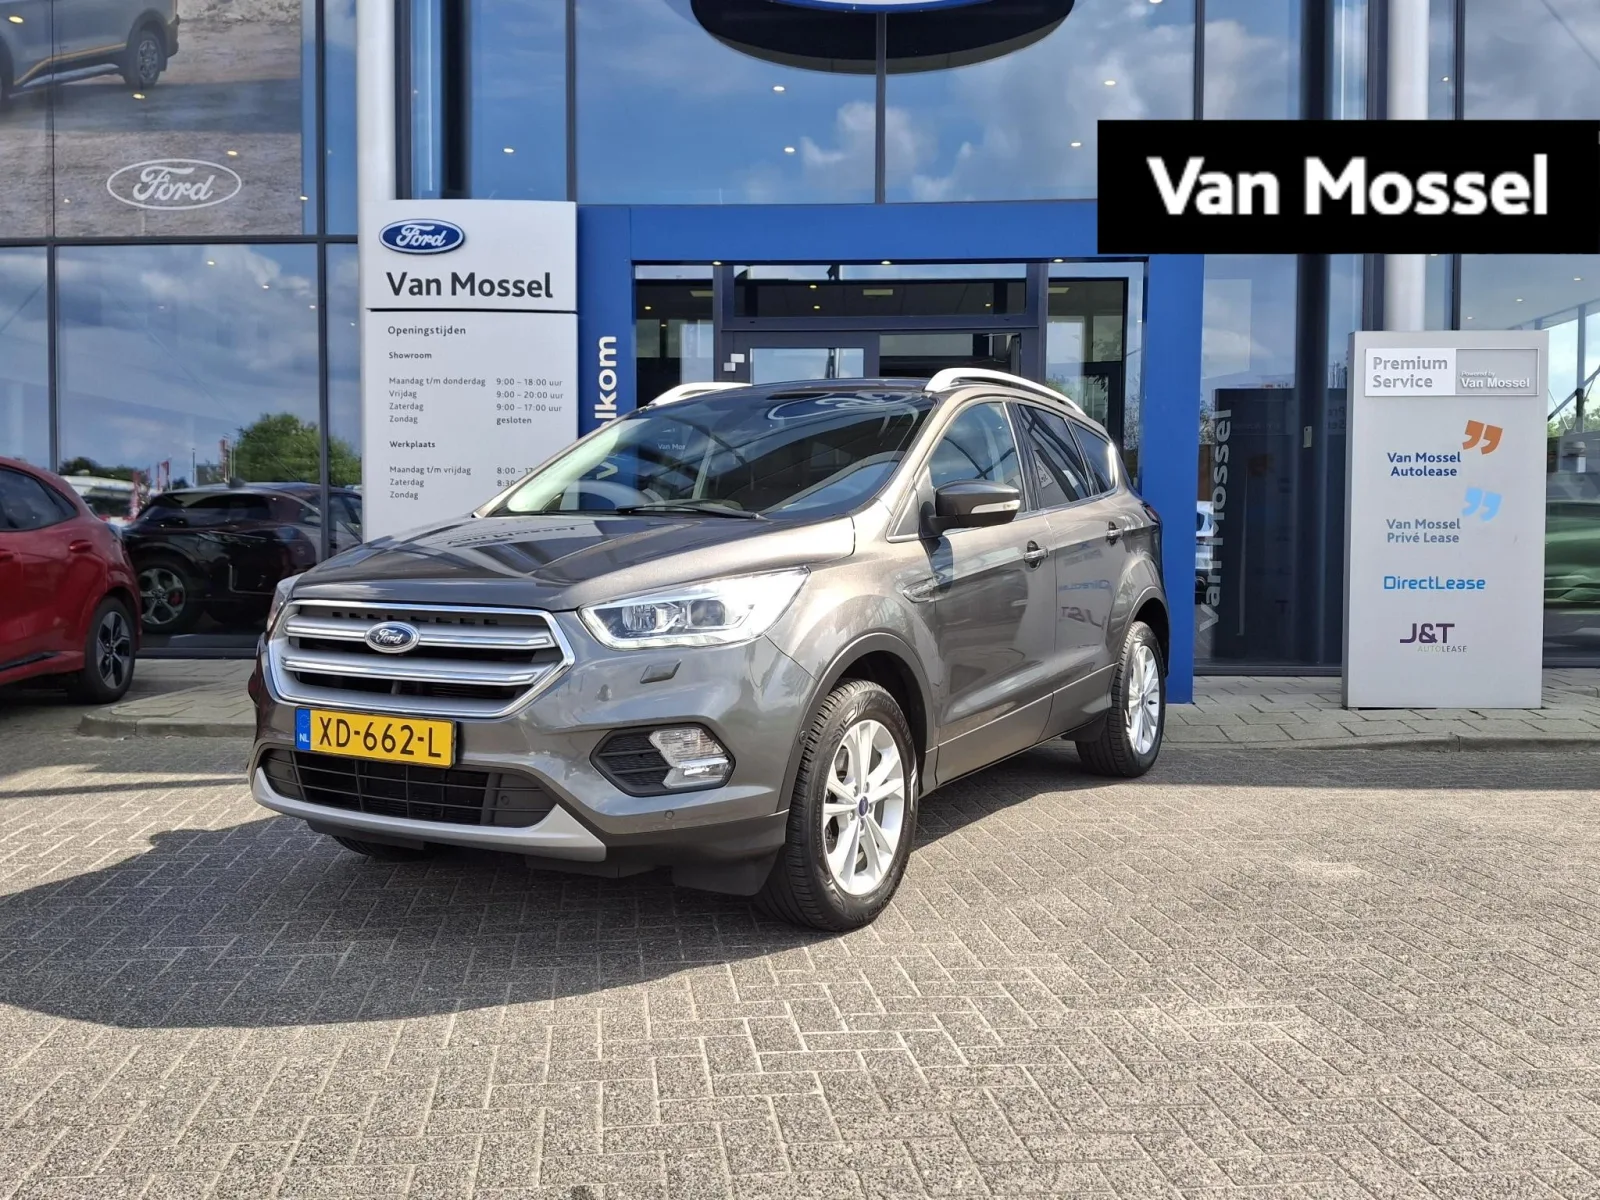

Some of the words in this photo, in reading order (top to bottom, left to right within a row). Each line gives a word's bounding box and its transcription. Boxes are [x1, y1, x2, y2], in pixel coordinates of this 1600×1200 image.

[133, 166, 215, 201] Ford
[395, 224, 447, 247] Ford
[385, 271, 442, 297] Van
[450, 271, 554, 299] Mossel
[387, 325, 467, 337] Openingstijden
[388, 351, 433, 359] Showroom
[1373, 355, 1448, 371] Premium
[388, 376, 425, 387] Maandag
[426, 377, 442, 386] t/m
[442, 376, 486, 388] donderdag
[496, 377, 515, 386] 9:00
[524, 378, 547, 386] 18:00
[1372, 373, 1433, 389] Service
[1461, 378, 1484, 388] Van
[1487, 378, 1530, 388] Mossel
[388, 389, 418, 400] Vrijdag
[496, 390, 515, 399] 9:00
[523, 390, 548, 399] 20:00
[389, 401, 424, 412] Zaterdag
[496, 403, 515, 411] 9:00
[524, 403, 547, 412] 17:00
[389, 414, 419, 425] Zondag
[496, 415, 532, 426] gesloten
[389, 440, 436, 450] Werkplaats
[1386, 452, 1412, 463] Van
[1415, 451, 1462, 463] Mossel
[389, 465, 425, 476] Maandag
[427, 465, 442, 474] t/m
[443, 465, 472, 476] vrijdag
[496, 466, 516, 475] 8:00
[1390, 464, 1458, 477] Autolease
[389, 478, 425, 488] Zaterdag
[1208, 409, 1232, 546] Mossel
[389, 490, 419, 501] Zondag
[1385, 518, 1412, 530] Van
[1414, 517, 1461, 530] Mossel
[1387, 531, 1421, 544] Privé
[1423, 532, 1460, 544] Lease
[1383, 575, 1486, 590] DirectLease
[1199, 560, 1222, 632] Van
[376, 628, 402, 643] Ford
[1399, 622, 1456, 644] J&T
[1417, 645, 1467, 653] AUTOLEASE
[299, 733, 309, 743] NL
[319, 716, 441, 758] XD-662-L
